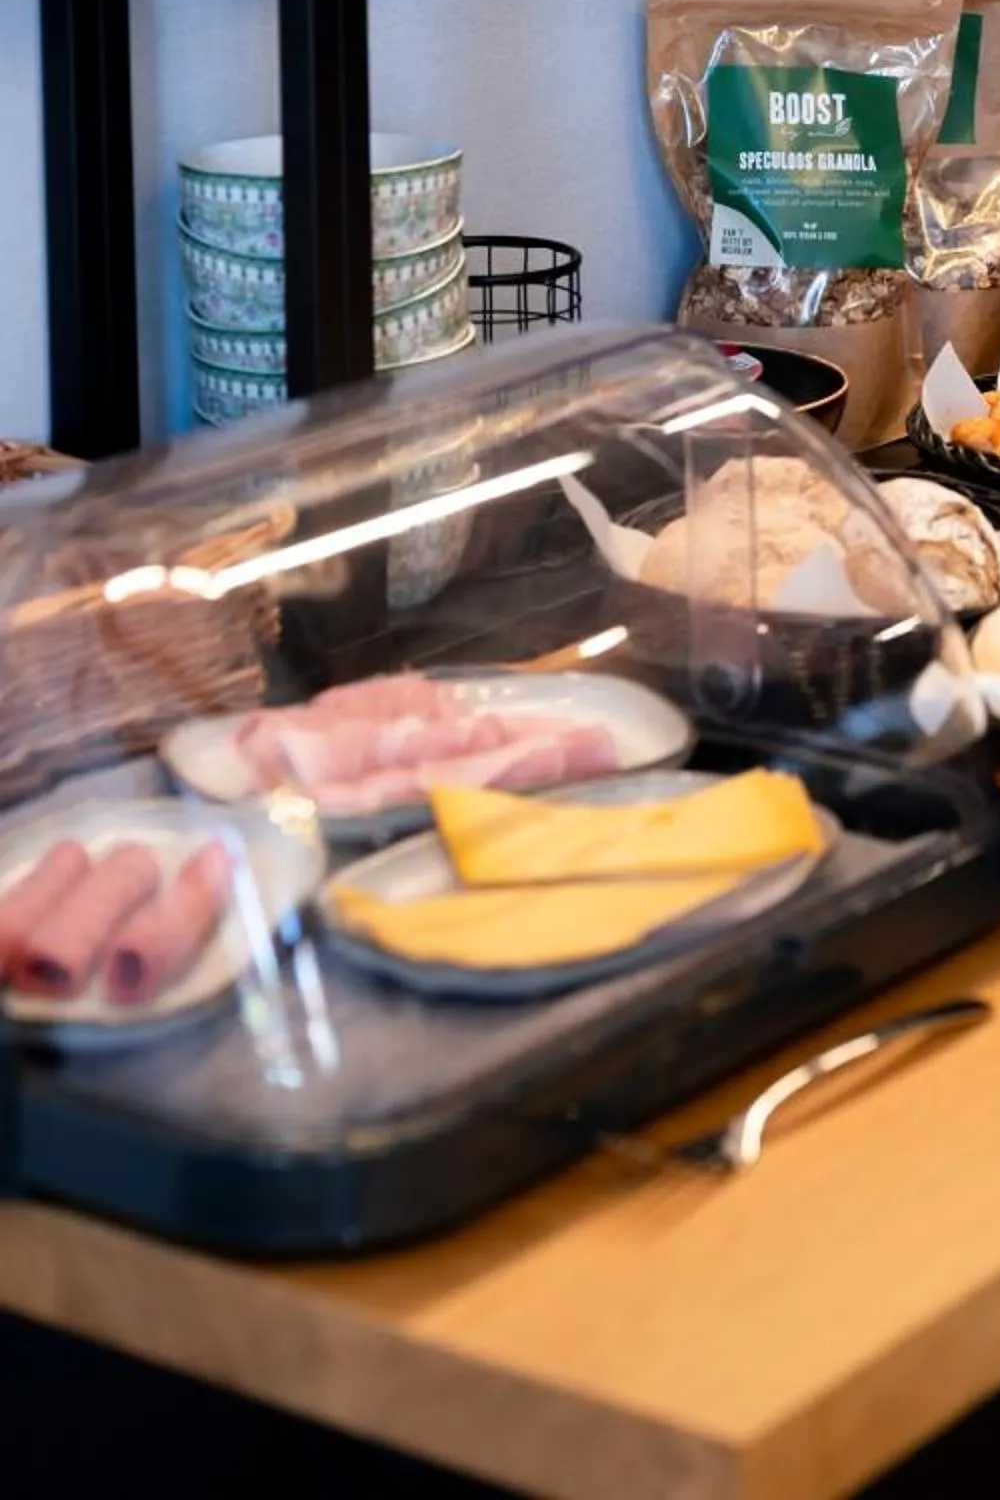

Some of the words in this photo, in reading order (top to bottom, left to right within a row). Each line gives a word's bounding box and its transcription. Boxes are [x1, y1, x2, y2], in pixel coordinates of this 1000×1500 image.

[769, 92, 846, 125] BOOST
[739, 151, 814, 171] SPECULOOS
[817, 152, 877, 172] GRANOLA
